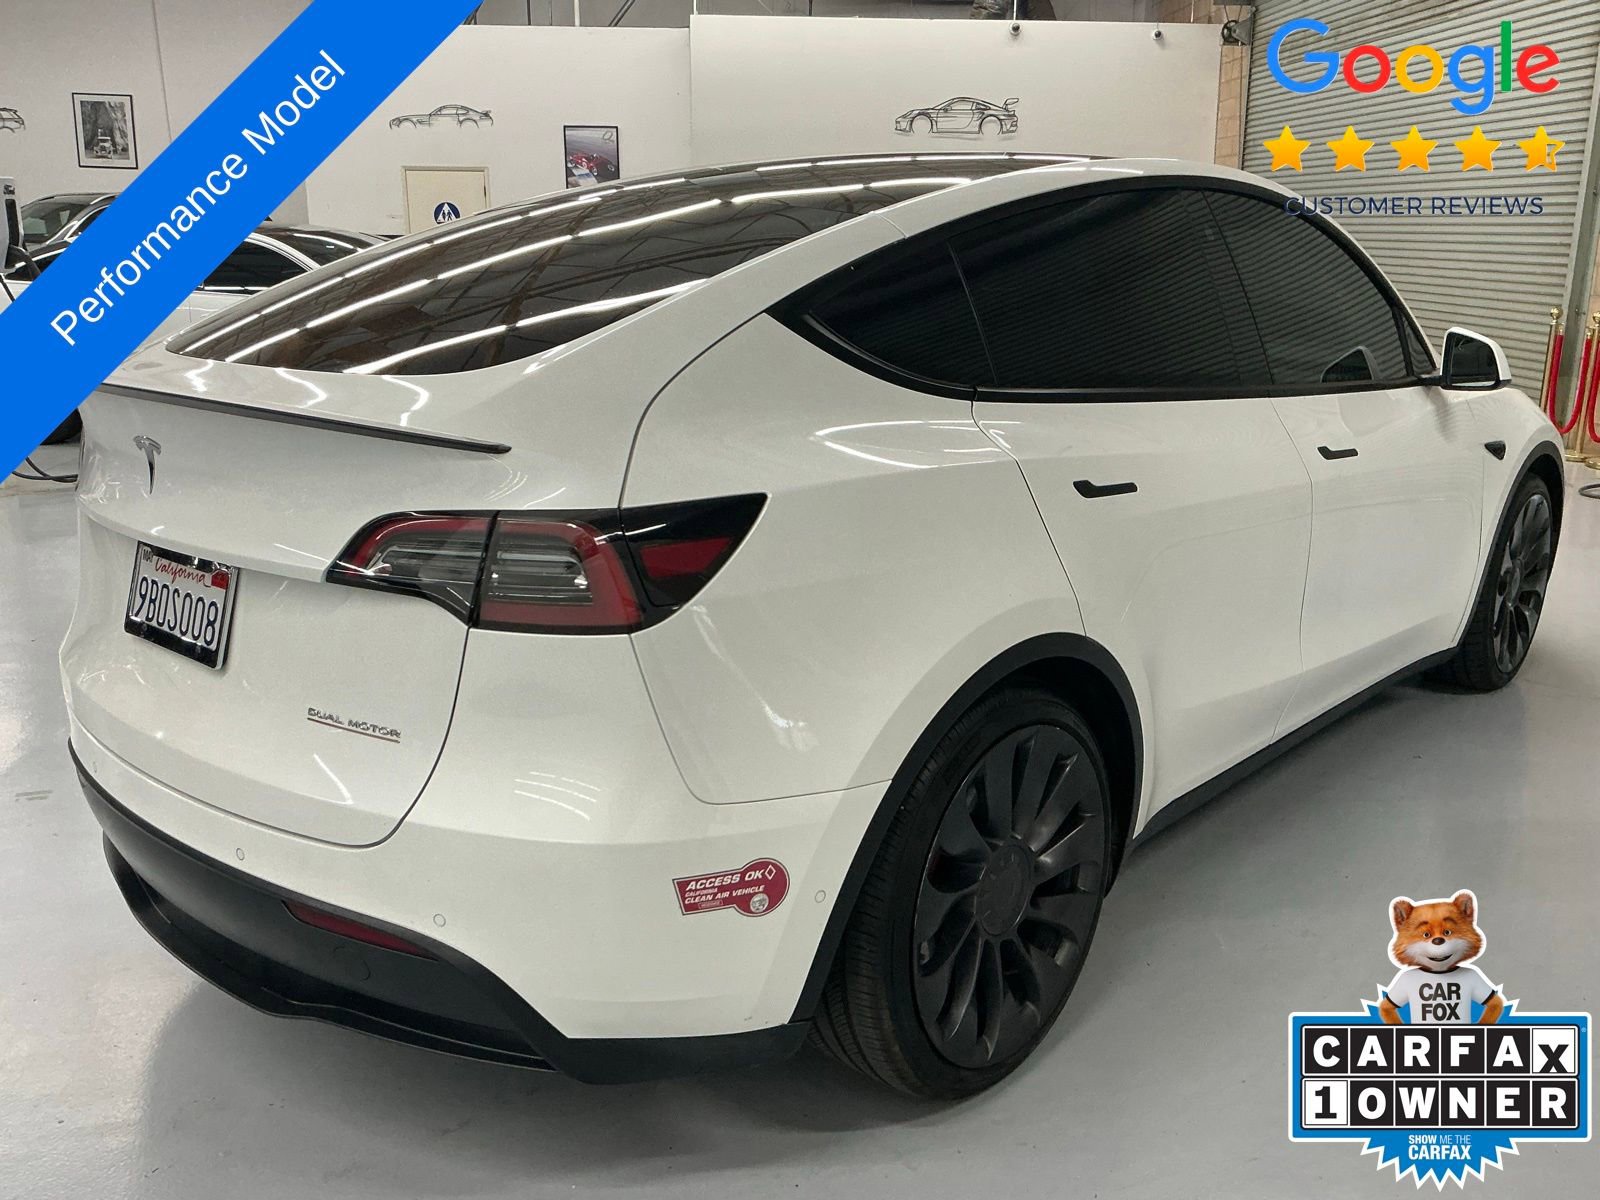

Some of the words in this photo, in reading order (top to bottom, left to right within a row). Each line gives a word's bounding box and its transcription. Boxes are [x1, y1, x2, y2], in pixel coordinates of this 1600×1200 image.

[155, 558, 212, 588] California
[307, 707, 345, 726] DUAL
[347, 718, 401, 739] MOTOR
[685, 873, 742, 892] ACCESS
[745, 868, 765, 881] OK
[685, 887, 719, 898] CALIFORNIA
[685, 893, 714, 905] CLEAN
[715, 890, 731, 900] AIR
[732, 884, 766, 897] VEHICLE
